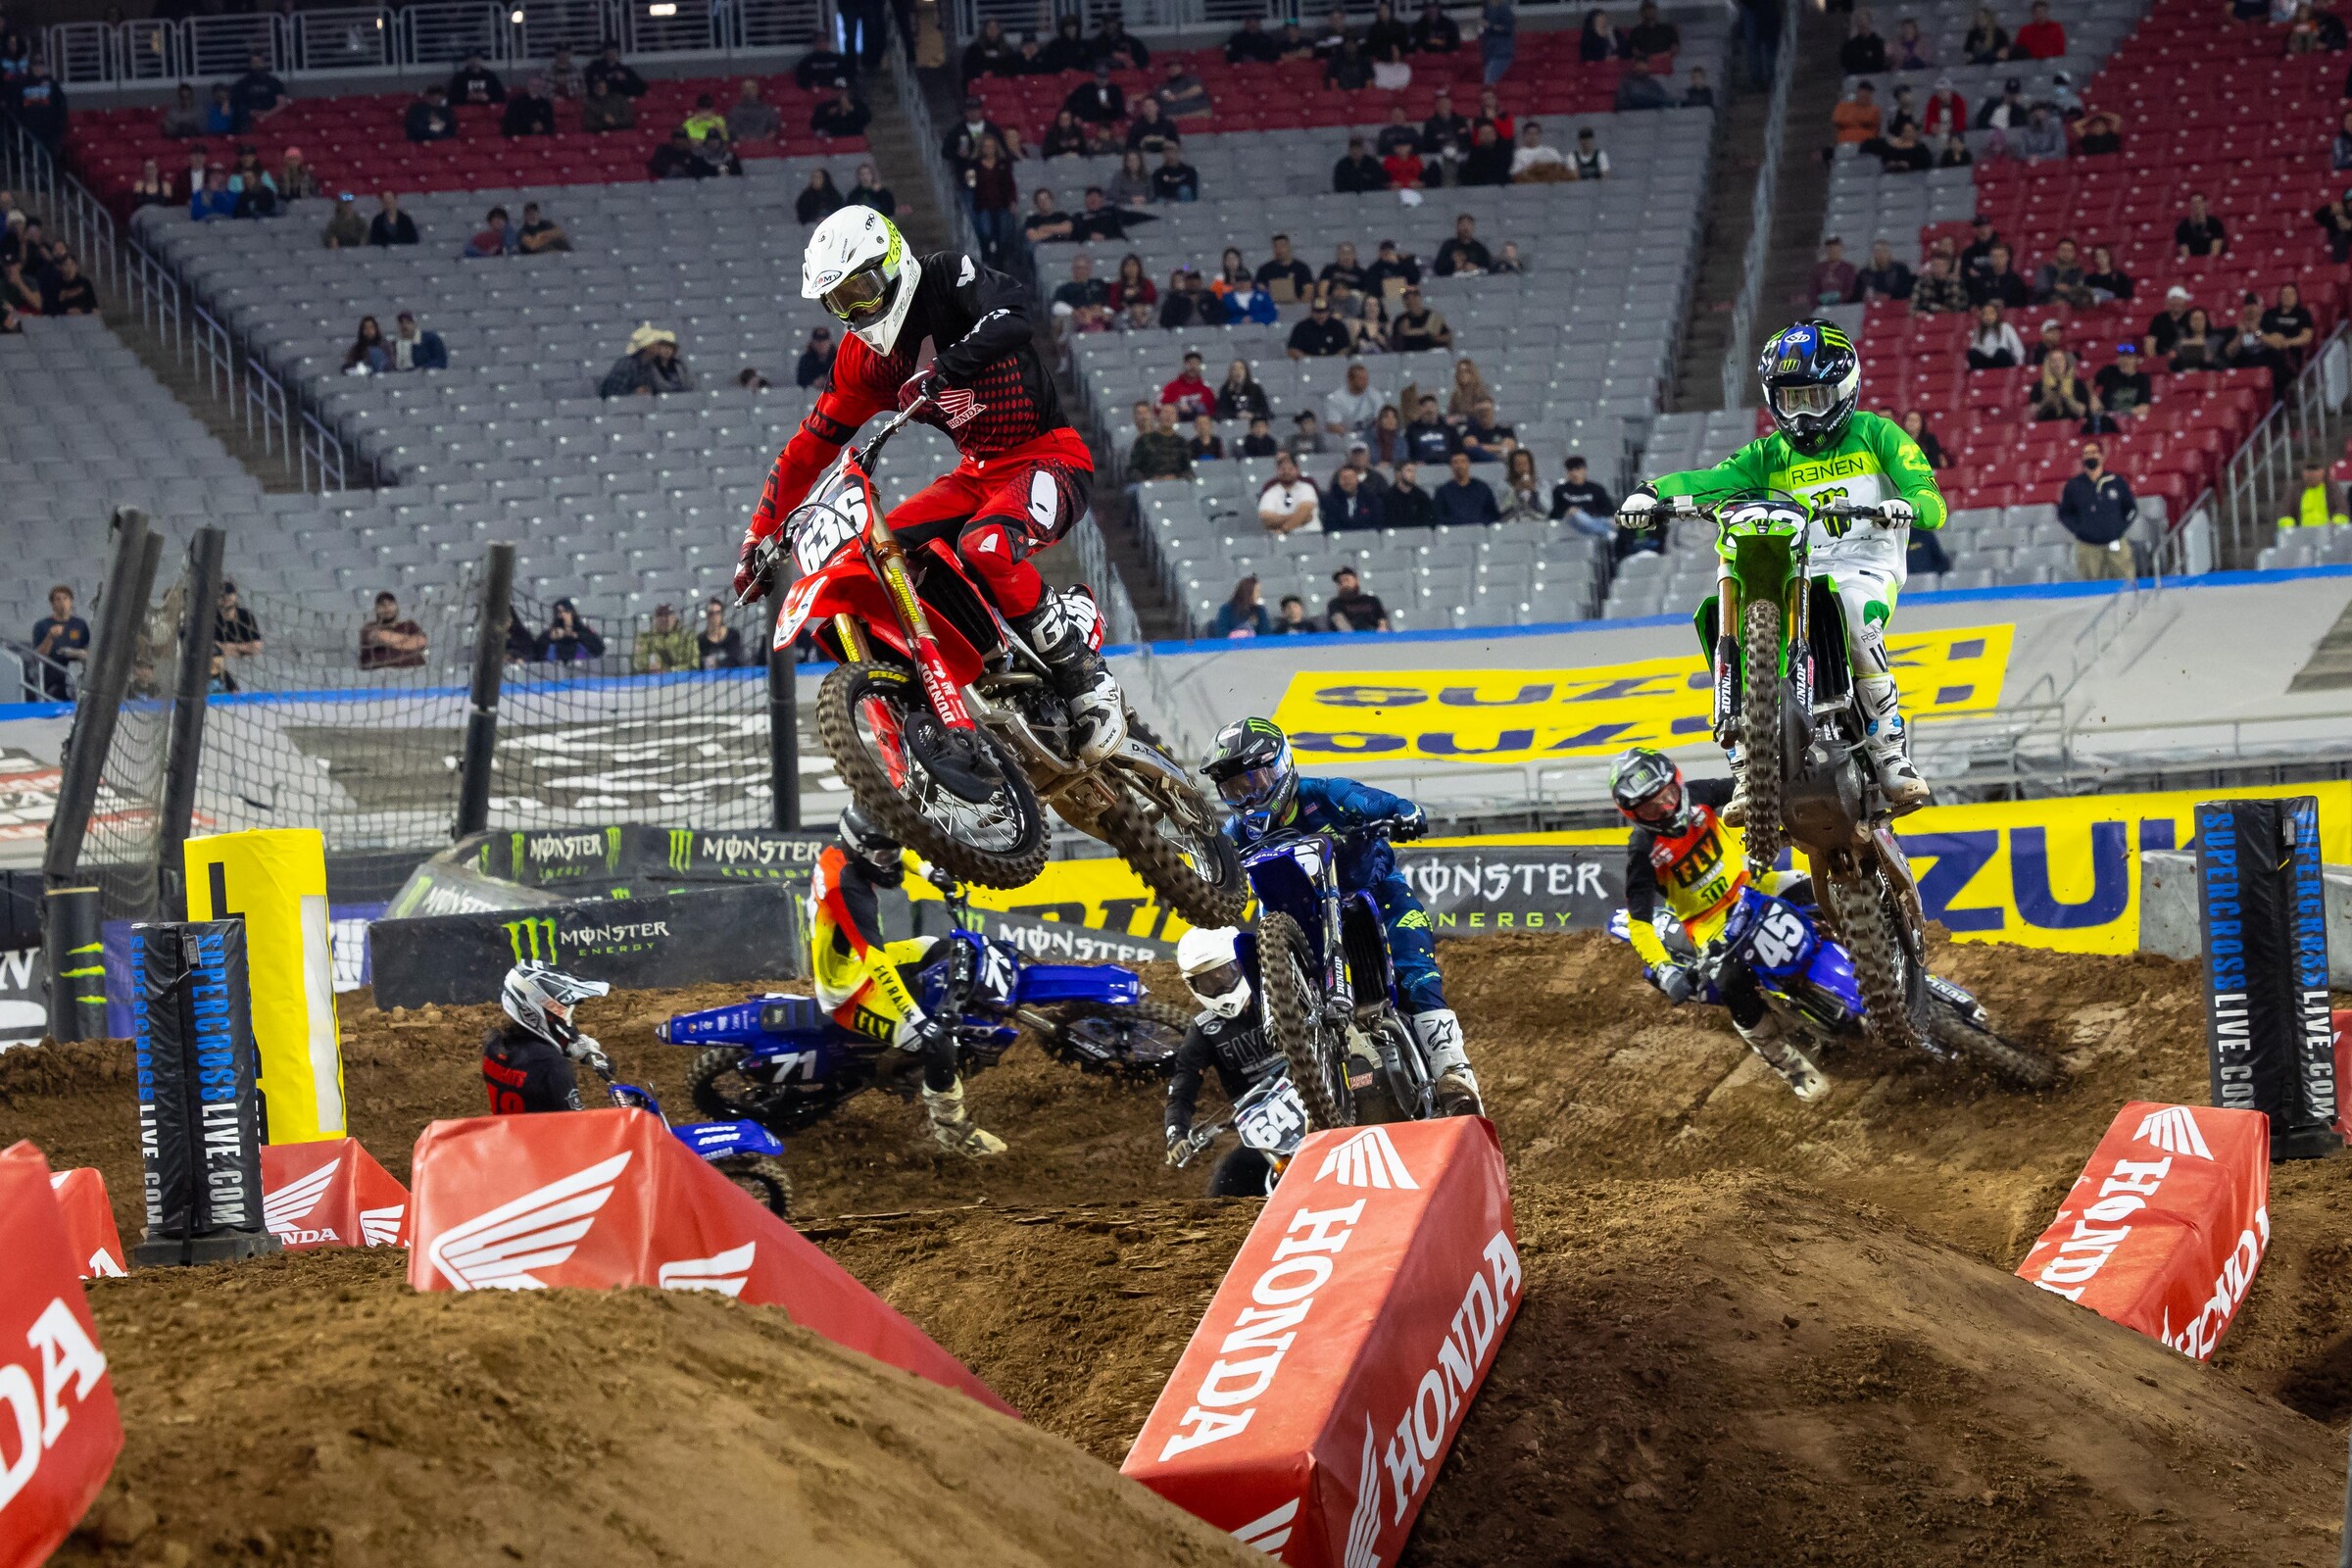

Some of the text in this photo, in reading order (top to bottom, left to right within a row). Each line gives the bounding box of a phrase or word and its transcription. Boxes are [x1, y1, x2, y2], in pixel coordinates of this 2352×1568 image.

[946, 403, 987, 429] HONDA
[798, 486, 869, 576] 636
[1796, 662, 1807, 707] UNLOP
[530, 832, 603, 862] MONSTER
[702, 834, 821, 865] MONSTER
[1402, 848, 1609, 905] MONSTER
[561, 920, 670, 947] MONSTER
[1438, 912, 1572, 928] NERGY
[1752, 903, 1806, 969] 45
[579, 942, 655, 956] ENERGY
[998, 922, 1155, 962] MONSTER
[1333, 955, 1346, 997] DUNLOP
[858, 1012, 891, 1040] FLY
[190, 933, 247, 1225] SUPERCROSSLIVE.COM
[771, 1050, 817, 1084] 71
[1158, 1198, 1367, 1463] HONDA
[1383, 1229, 1522, 1527] HONDA
